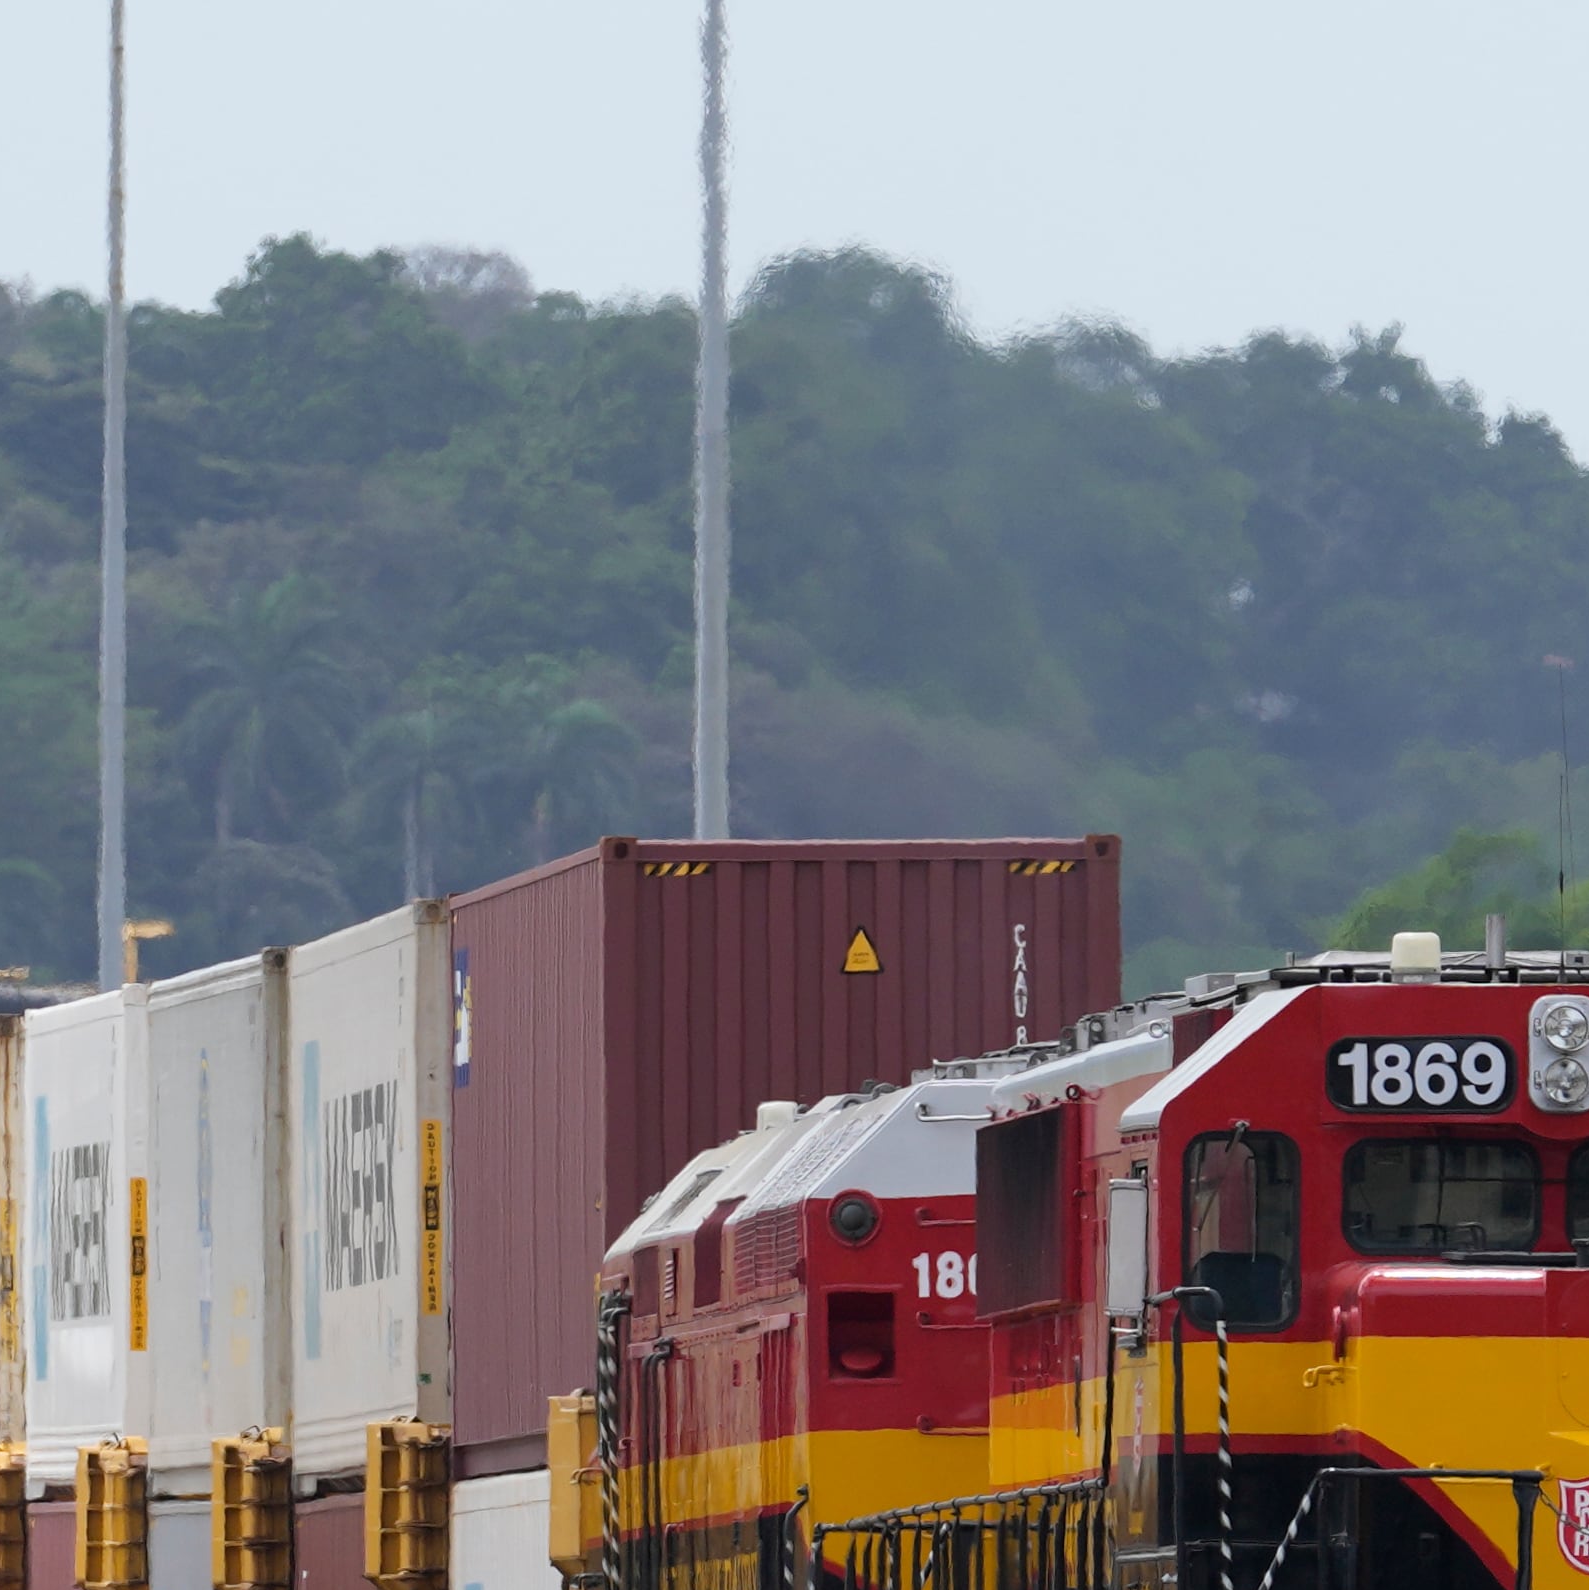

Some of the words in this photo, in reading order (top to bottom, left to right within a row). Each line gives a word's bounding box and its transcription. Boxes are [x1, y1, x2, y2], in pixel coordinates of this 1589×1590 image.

[1013, 923, 1028, 1018] CAAU
[1338, 1041, 1506, 1106] 1869
[323, 1079, 400, 1292] MAERSK
